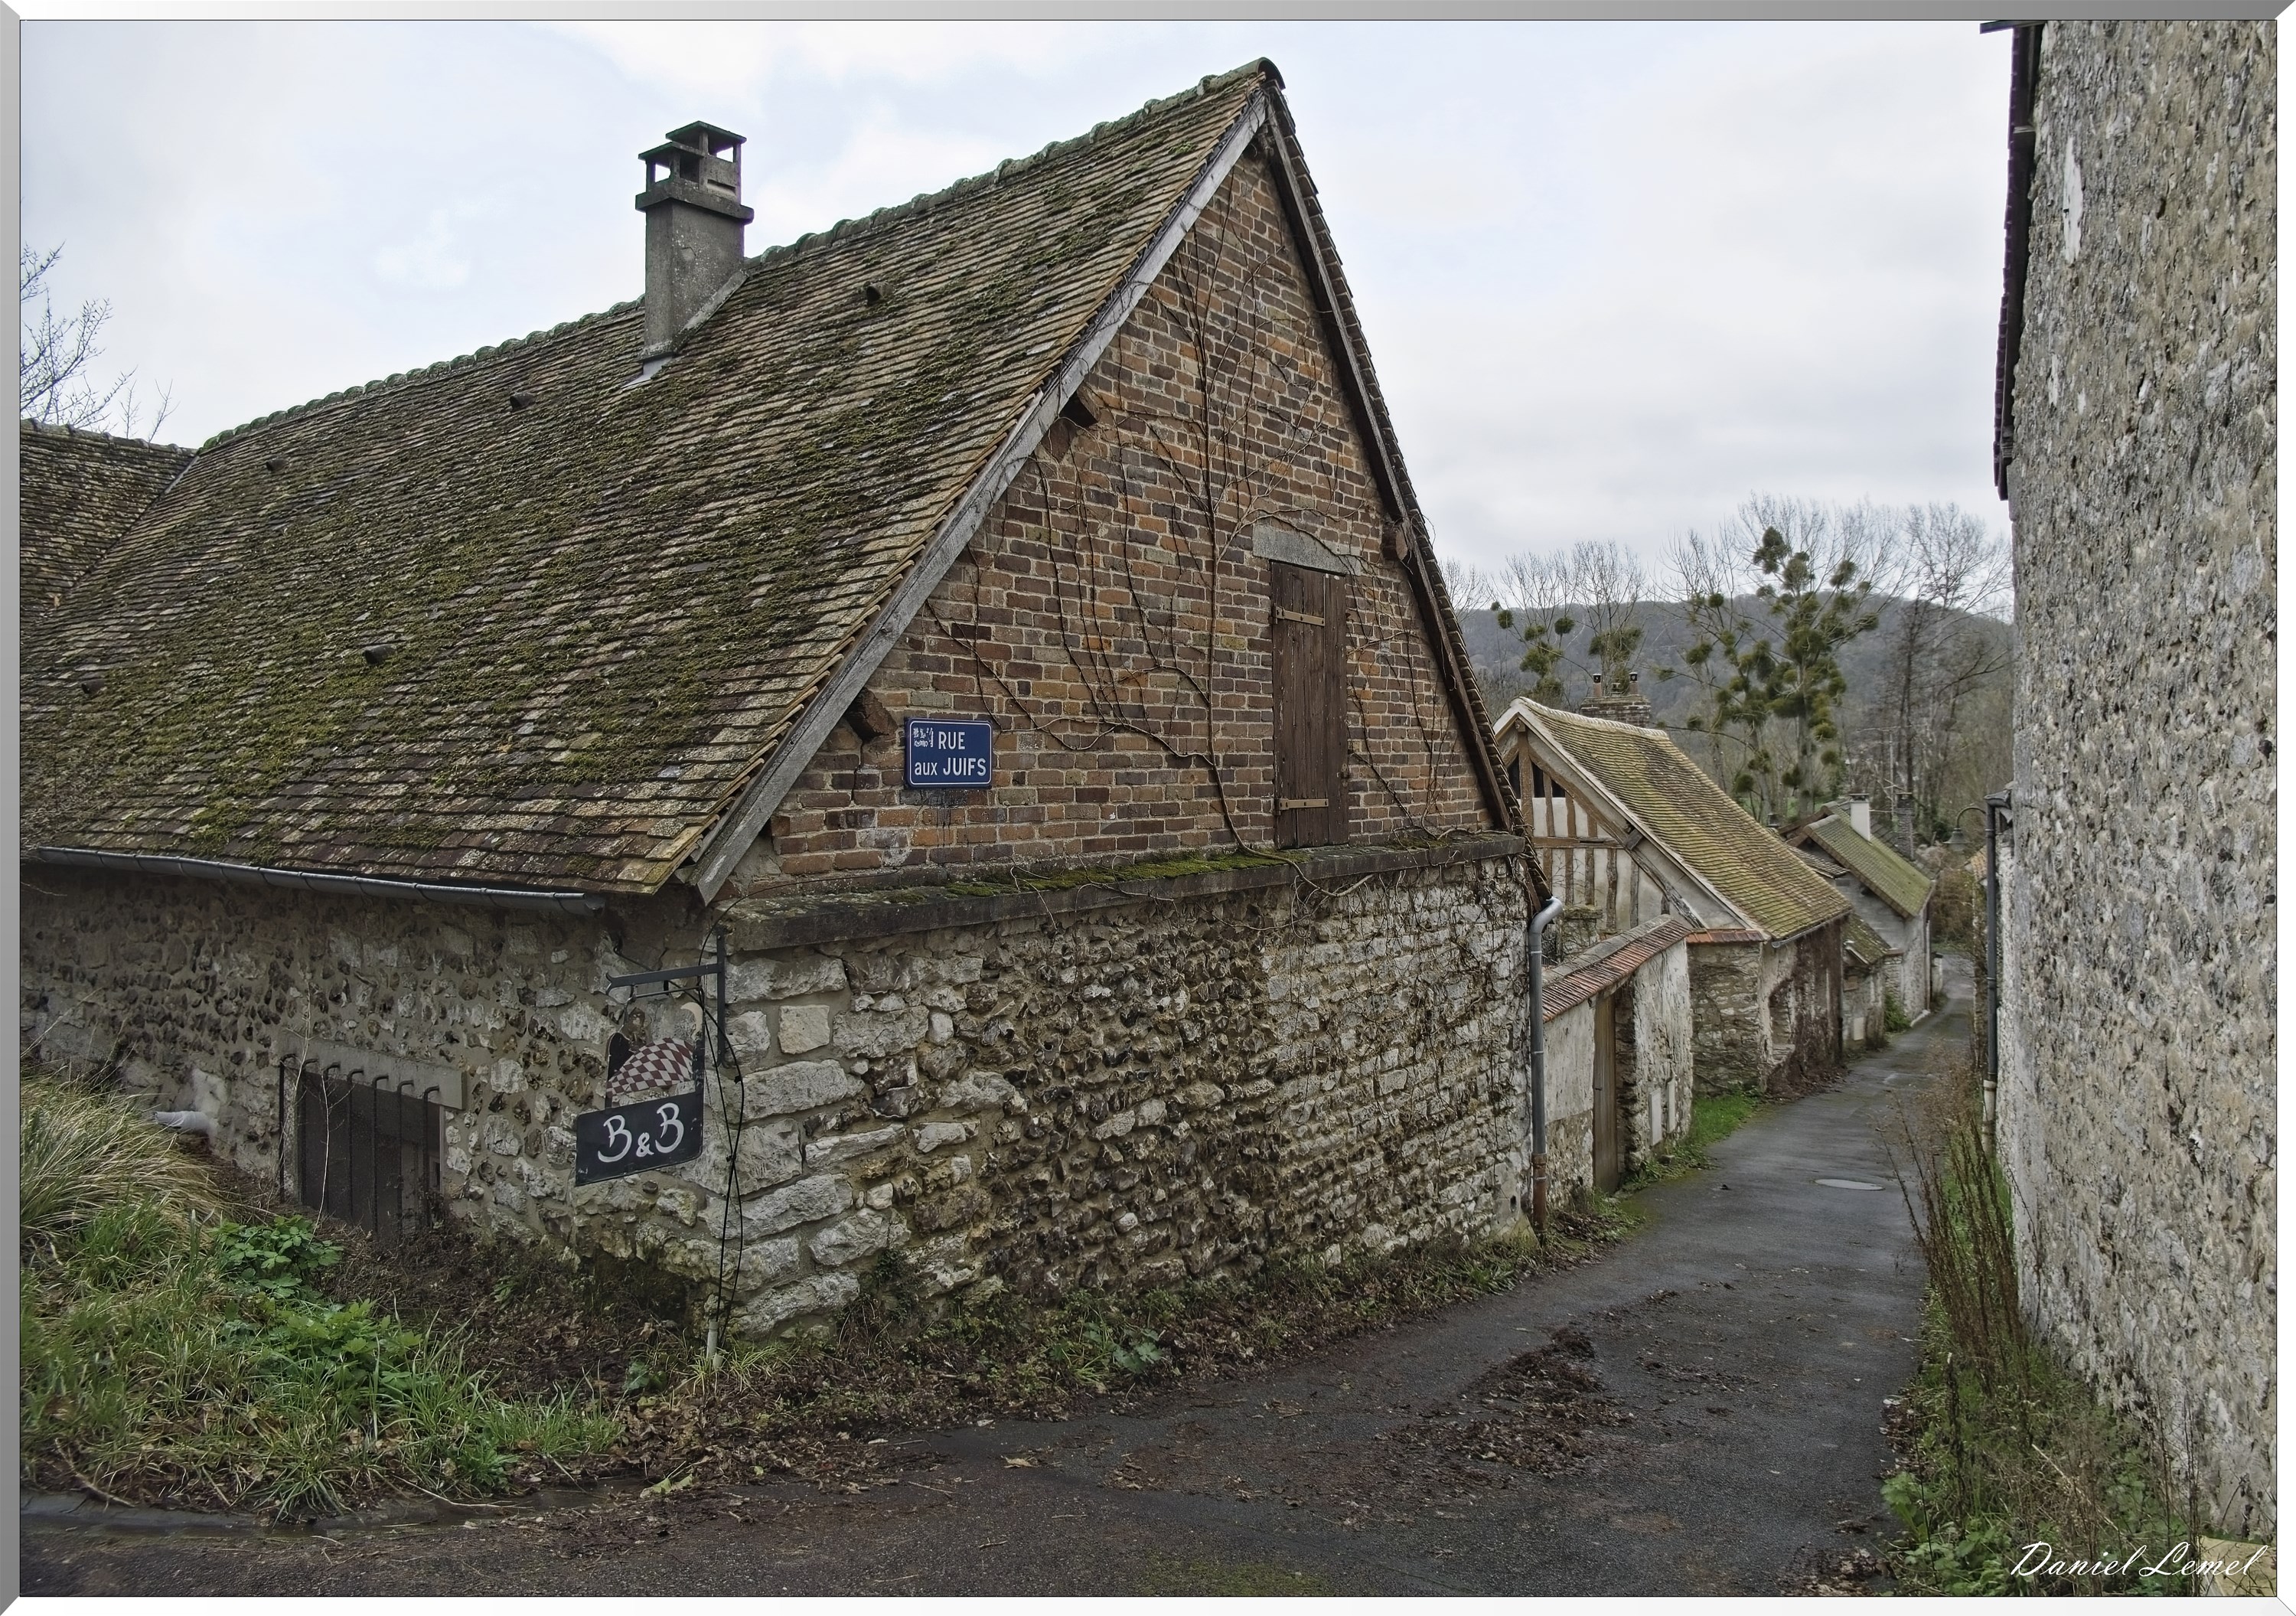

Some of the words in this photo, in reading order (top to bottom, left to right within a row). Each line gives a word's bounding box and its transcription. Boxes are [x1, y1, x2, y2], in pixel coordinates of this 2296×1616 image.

[938, 731, 965, 749] RUE
[915, 762, 938, 775] aux
[943, 757, 987, 776] JUIFS
